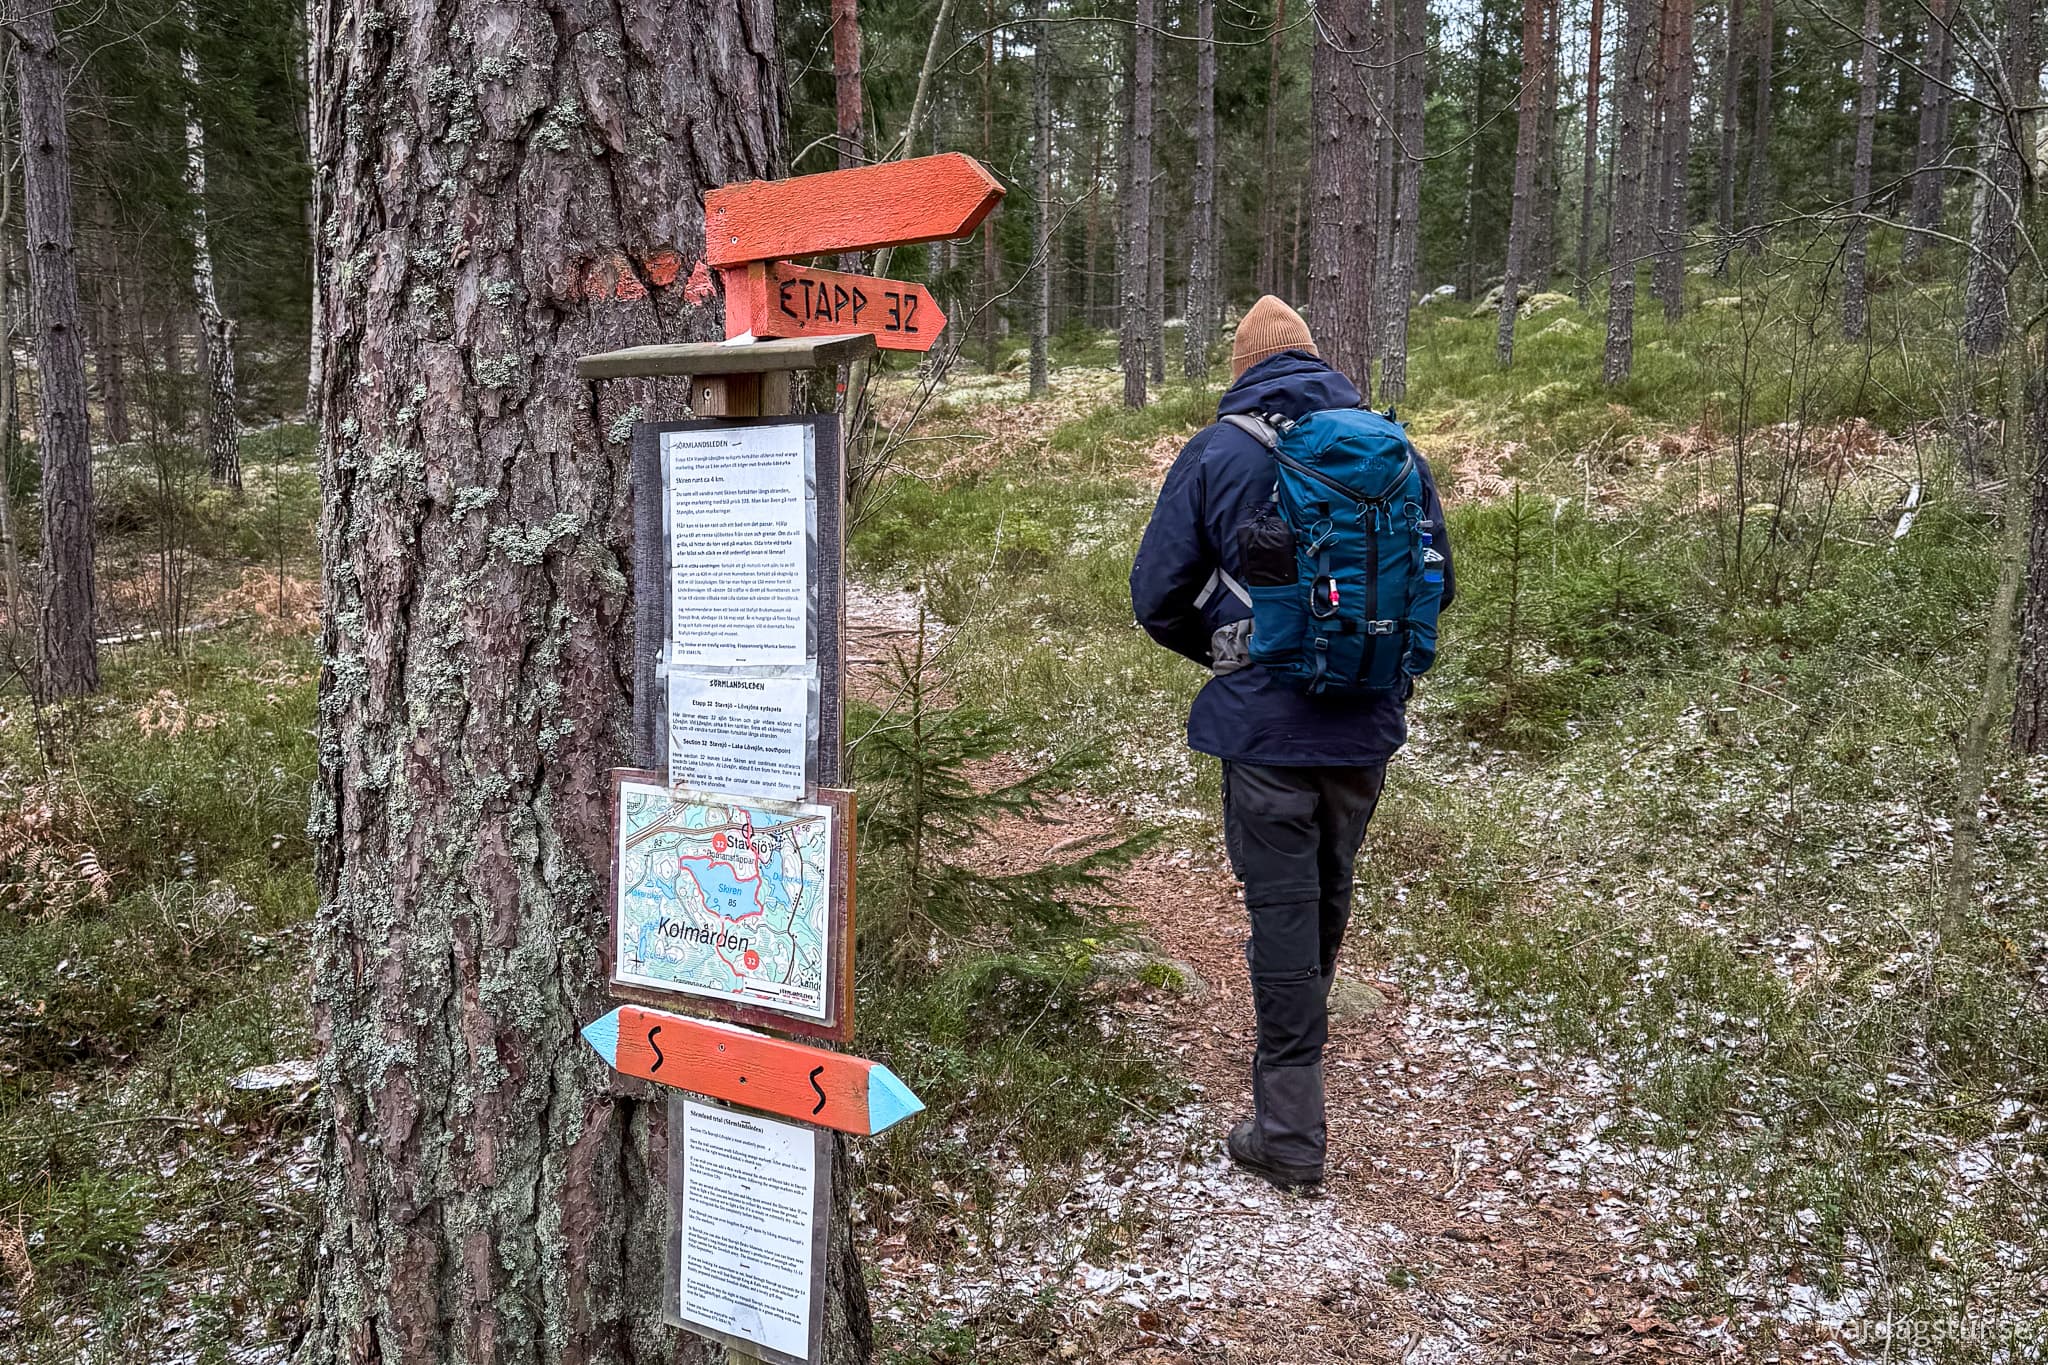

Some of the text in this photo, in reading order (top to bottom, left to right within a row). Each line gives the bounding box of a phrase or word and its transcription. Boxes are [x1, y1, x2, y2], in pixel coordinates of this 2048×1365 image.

[780, 278, 919, 333] ETAPP 32
[709, 679, 765, 690] SÖRMLANDSLEDEN
[726, 835, 768, 855] Stavsjö
[658, 916, 749, 953] Kolmården
